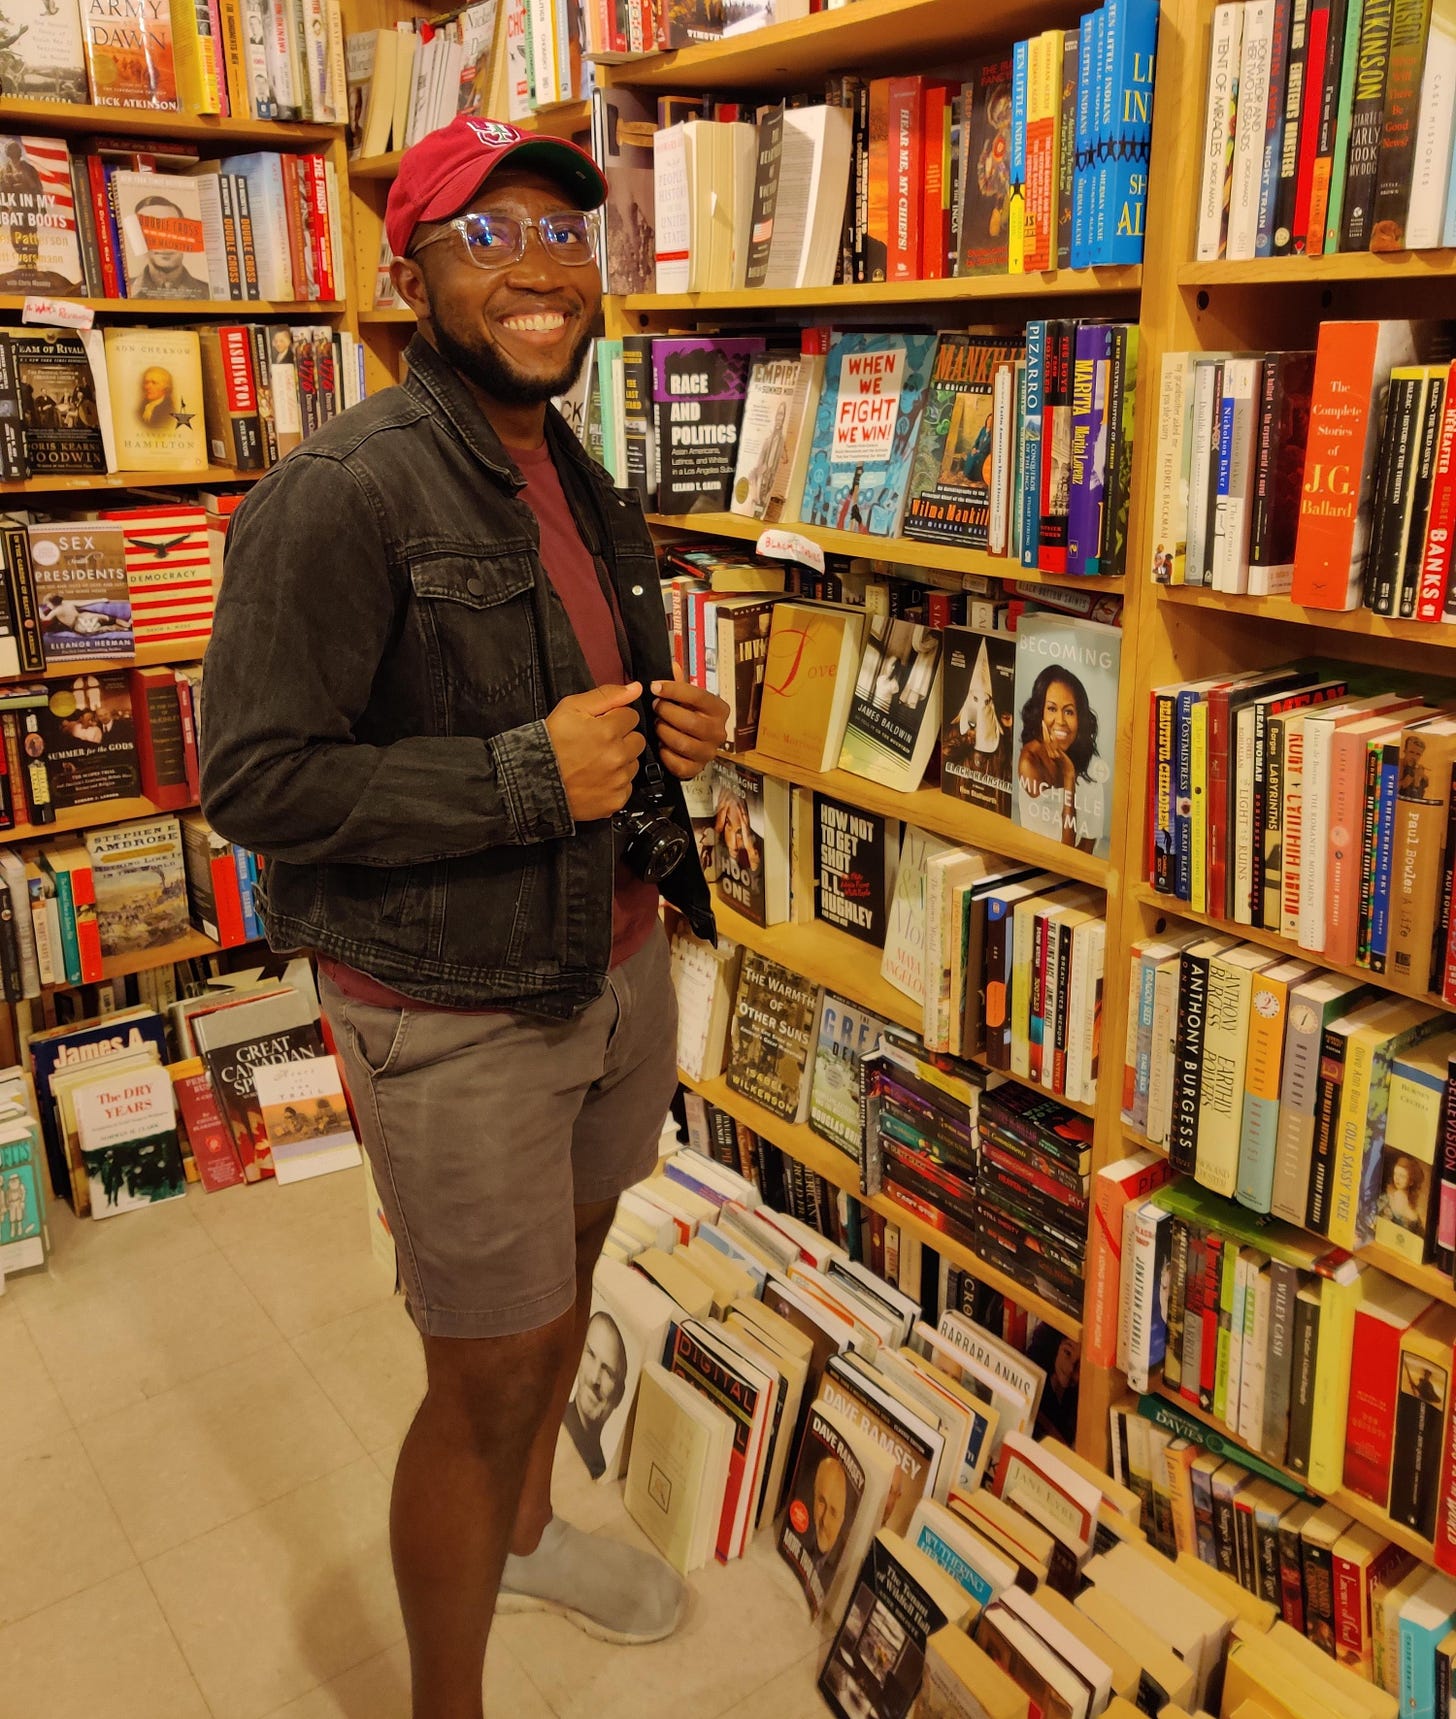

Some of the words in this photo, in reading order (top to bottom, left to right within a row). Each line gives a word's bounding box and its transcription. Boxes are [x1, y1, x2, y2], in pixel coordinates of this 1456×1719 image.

[92, 26, 165, 50] DAWN
[1217, 36, 1229, 69] TENT
[1270, 4, 1284, 76] MARTIN
[1016, 46, 1025, 71] TEN
[1015, 73, 1024, 117] LITTLE
[1215, 74, 1226, 92] OF
[1286, 62, 1303, 119] EINSTEIN'S
[1433, 74, 1441, 107] CASE
[96, 96, 128, 108] RICK
[130, 97, 177, 111] ATKINSON
[1267, 84, 1278, 130] AMIS
[900, 109, 909, 147] HEAR
[1014, 121, 1023, 166] INDIANS
[1210, 97, 1225, 157] MIRACLES
[1352, 126, 1382, 147] EARLY,
[898, 149, 908, 173] ME,
[1262, 146, 1272, 185] NIGHT
[1281, 122, 1298, 178] MONSTERS
[1350, 146, 1377, 161] TOOK
[1422, 116, 1436, 187] HISTORIES
[313, 157, 324, 179] THE
[899, 175, 908, 196] MY
[19, 194, 34, 207] IN
[36, 195, 56, 209] MY
[315, 180, 327, 214] FINISH
[1259, 189, 1269, 229] TRAIN
[28, 213, 67, 228] BOOTS
[898, 198, 909, 250] CHIEFS!
[15, 231, 69, 246] Patterson
[227, 333, 250, 408] WASHINGTON
[849, 355, 896, 375] WHEN
[1027, 326, 1040, 409] PIZARRO
[671, 374, 708, 394] RACE
[859, 377, 882, 394] WE
[1072, 360, 1094, 416] MARITA
[1330, 380, 1351, 393] The
[671, 402, 700, 421] AND
[840, 398, 896, 423] FIGHT
[1312, 404, 1362, 420] Complete
[124, 440, 194, 449] HAMILTON
[239, 420, 249, 457] CHERNOW
[248, 431, 256, 446] RON
[672, 425, 736, 445] POLITICS
[1438, 409, 1454, 474] HEREAFTER
[1302, 499, 1352, 518] Ballard
[59, 535, 95, 550] SEX
[35, 567, 125, 583] PRESIDENTS
[130, 569, 197, 583] DEMOCRACY
[673, 589, 682, 635] ERASURE
[734, 604, 761, 616] RALPH
[50, 640, 91, 650] ELEANOR
[94, 638, 131, 648] HERMAN
[1019, 634, 1113, 670] BECOMING
[1182, 695, 1191, 713] THE
[858, 704, 880, 722] JAMES
[881, 718, 913, 744] BALDWIN
[1159, 700, 1172, 761] BEAUTIFUL
[1269, 727, 1278, 755] Borges
[48, 748, 85, 761] SUMMER
[86, 747, 96, 756] for
[97, 745, 108, 753] the
[108, 742, 134, 752] GODS
[1180, 715, 1192, 791] POSTMISTRESS
[1287, 733, 1304, 774] RUBY
[1017, 775, 1102, 817] MICHELLE
[1158, 763, 1170, 832] CHILDREN
[1268, 763, 1278, 830] LABYRINTHS
[94, 827, 162, 843] STEPHEN
[821, 803, 848, 832] HOW
[850, 813, 874, 843] NOT
[1028, 803, 1089, 838] OBAMA
[1286, 794, 1303, 866] CYNTHIA
[94, 832, 178, 853] AMBROSE
[821, 824, 836, 846] TO
[837, 832, 859, 857] GET
[821, 845, 851, 870] SHOT
[722, 877, 751, 908] ONE
[821, 893, 873, 930] HUGHLEY
[896, 947, 921, 972] MAYA
[745, 968, 765, 984] THE
[768, 976, 816, 1008] WARMTH
[769, 999, 784, 1012] OF
[1206, 965, 1226, 1030] BURGESS
[1222, 972, 1241, 1035] ANTHONY
[739, 1002, 776, 1029] OTHER
[779, 1020, 809, 1045] SUNS
[1186, 964, 1205, 1055] ANTHONY
[55, 1032, 122, 1068] James
[120, 1028, 143, 1047] A.
[236, 1036, 290, 1063] GREAT
[98, 1091, 122, 1105] The
[123, 1083, 153, 1099] DRY
[280, 1089, 325, 1100] TRAIL
[732, 1075, 794, 1114] WILKERSON
[746, 1067, 783, 1094] ISABEL
[1201, 1048, 1216, 1108] POWERS
[1213, 1055, 1236, 1119] EARTHLY
[104, 1099, 152, 1120] YEARS
[1179, 1061, 1198, 1149] BURGESS
[715, 1114, 724, 1145] BRANCH
[723, 1115, 732, 1145] TAYLOR
[1134, 1257, 1145, 1310] JONATHAN
[1131, 1312, 1143, 1356] CARROLL
[1184, 1314, 1198, 1367] CARROLL
[680, 1335, 752, 1412] DIGITAL
[941, 1321, 990, 1367] BARBARA
[995, 1362, 1030, 1394] ANNIS
[823, 1383, 859, 1422] DAVE
[860, 1415, 921, 1480] RAMSEY
[1155, 1411, 1203, 1443] DAVIES
[813, 1419, 837, 1449] DAVE
[837, 1440, 865, 1489] RAMSEY
[1015, 1467, 1041, 1494] JANE
[925, 1531, 984, 1593] WUTHERING
[1262, 1535, 1277, 1571] Sharpe's
[877, 1571, 886, 1583] of
[886, 1579, 914, 1616] Wildfell
[915, 1613, 930, 1634] Hall
[888, 1565, 901, 1585] The
[904, 1583, 928, 1616] Tenant
[1264, 1576, 1277, 1599] Tiger
[1305, 1561, 1318, 1613] CORNWELL
[1317, 1568, 1331, 1618] BERNARD
